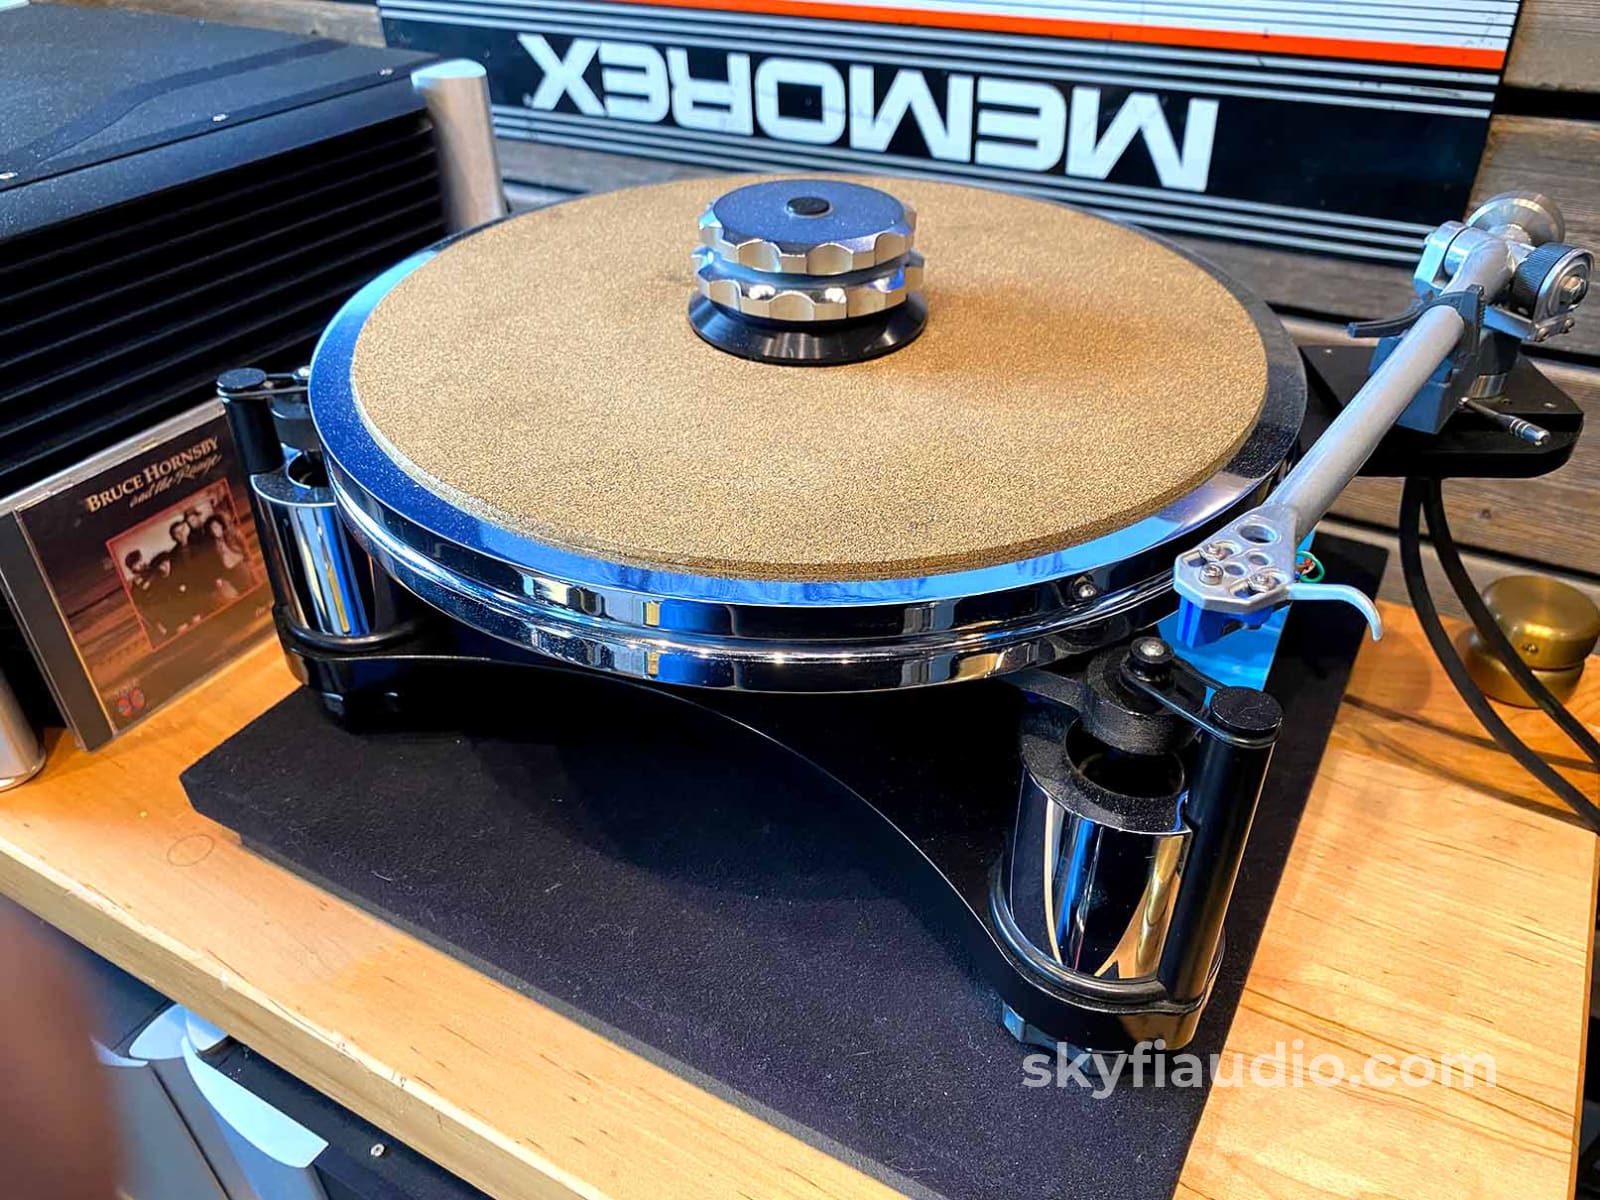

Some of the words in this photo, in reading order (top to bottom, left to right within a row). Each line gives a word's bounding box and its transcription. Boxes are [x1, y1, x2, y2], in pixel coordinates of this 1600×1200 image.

[517, 32, 1219, 192] MEMOREX
[85, 474, 144, 513] BRUCE
[143, 436, 218, 484] HORNSBY
[129, 482, 156, 508] and
